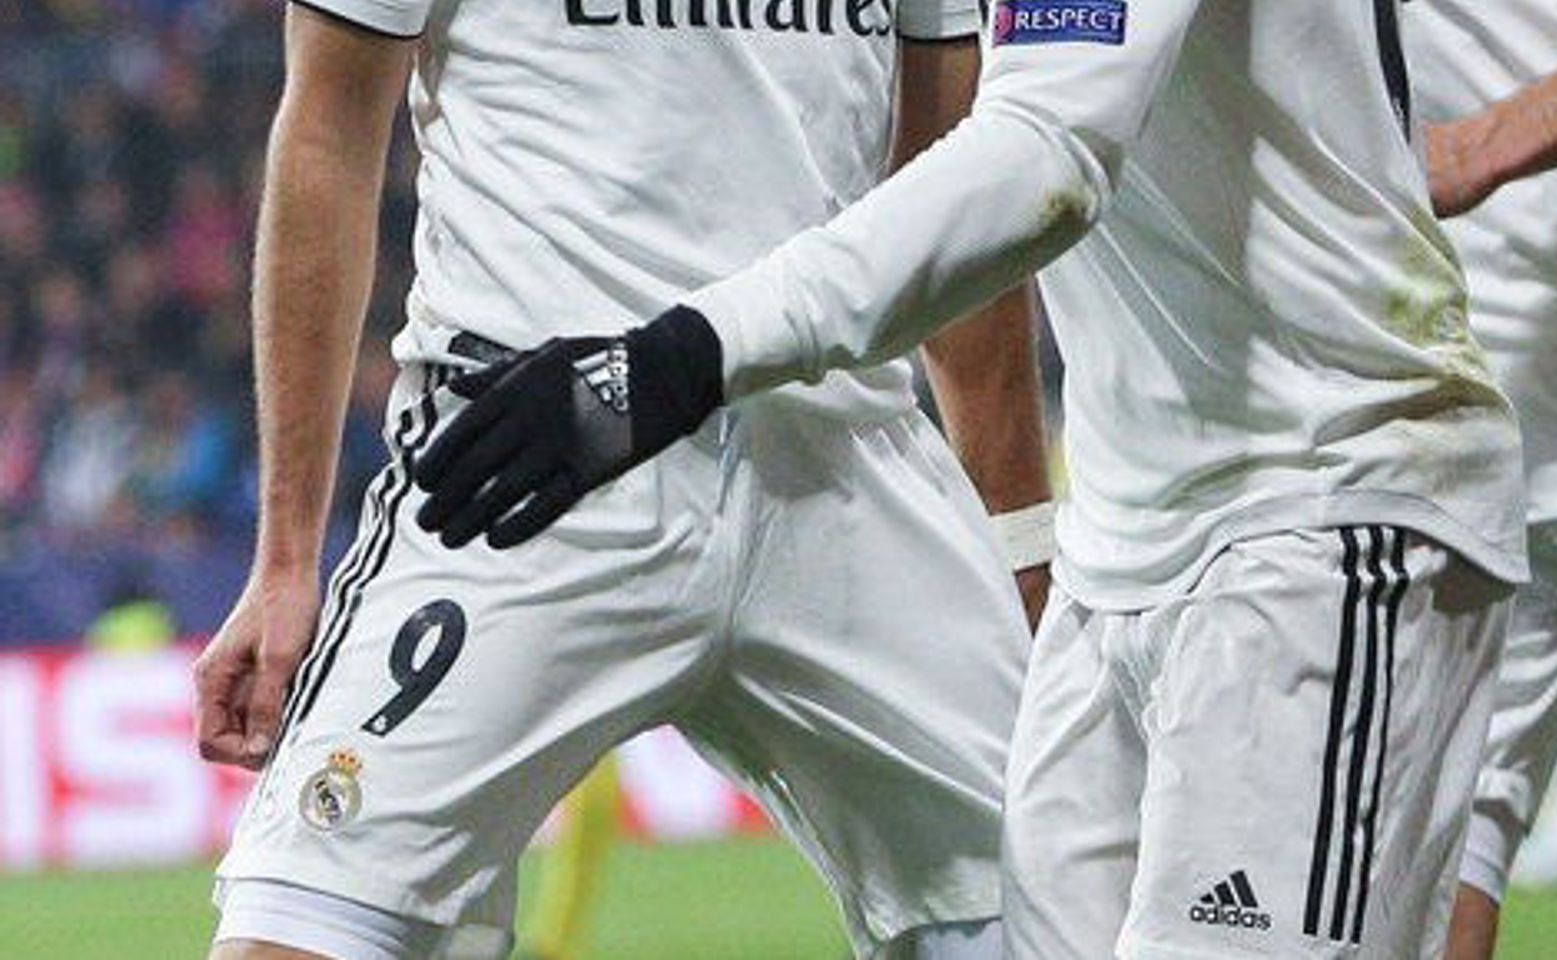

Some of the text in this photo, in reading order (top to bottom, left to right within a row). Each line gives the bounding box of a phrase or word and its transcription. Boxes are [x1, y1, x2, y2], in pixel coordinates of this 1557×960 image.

[1014, 7, 1122, 31] RESPECT
[361, 598, 466, 738] 9
[1190, 906, 1271, 931] adidas
